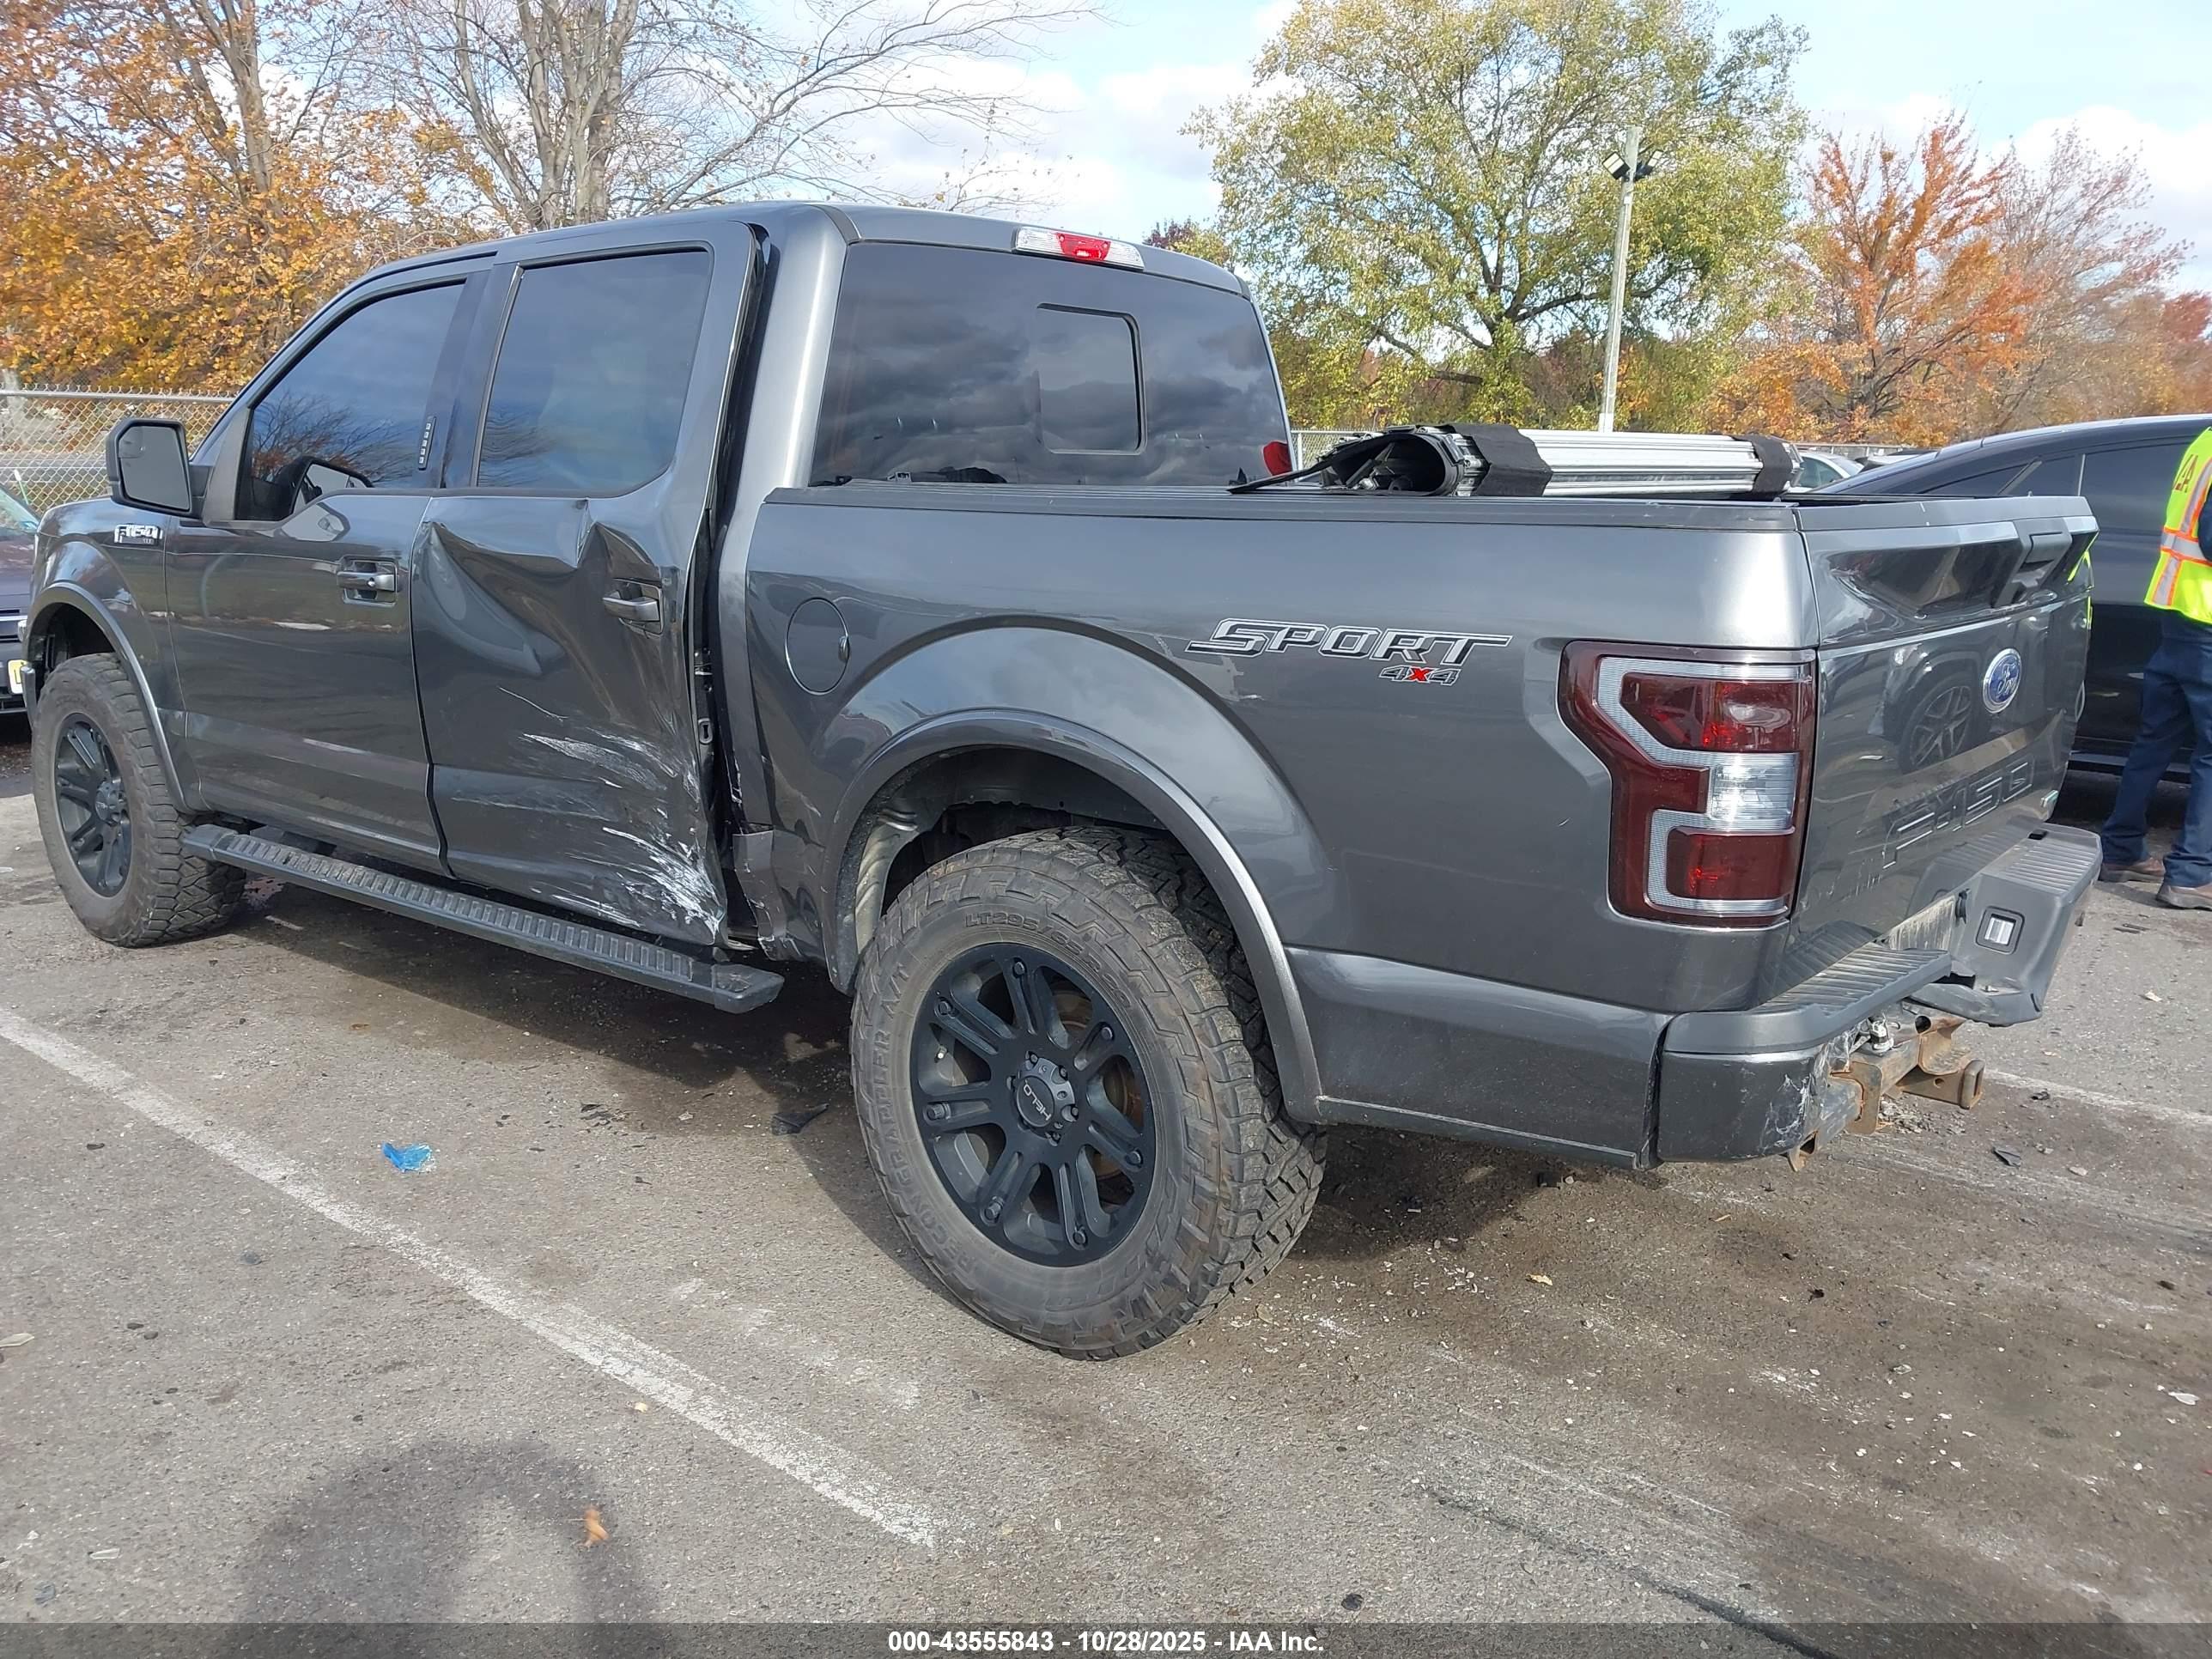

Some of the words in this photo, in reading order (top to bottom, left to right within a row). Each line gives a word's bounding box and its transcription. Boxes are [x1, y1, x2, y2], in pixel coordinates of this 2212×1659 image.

[1184, 617, 1514, 667] SPORT
[1881, 753, 2036, 870] F-150
[1023, 1079, 1052, 1121] HELO
